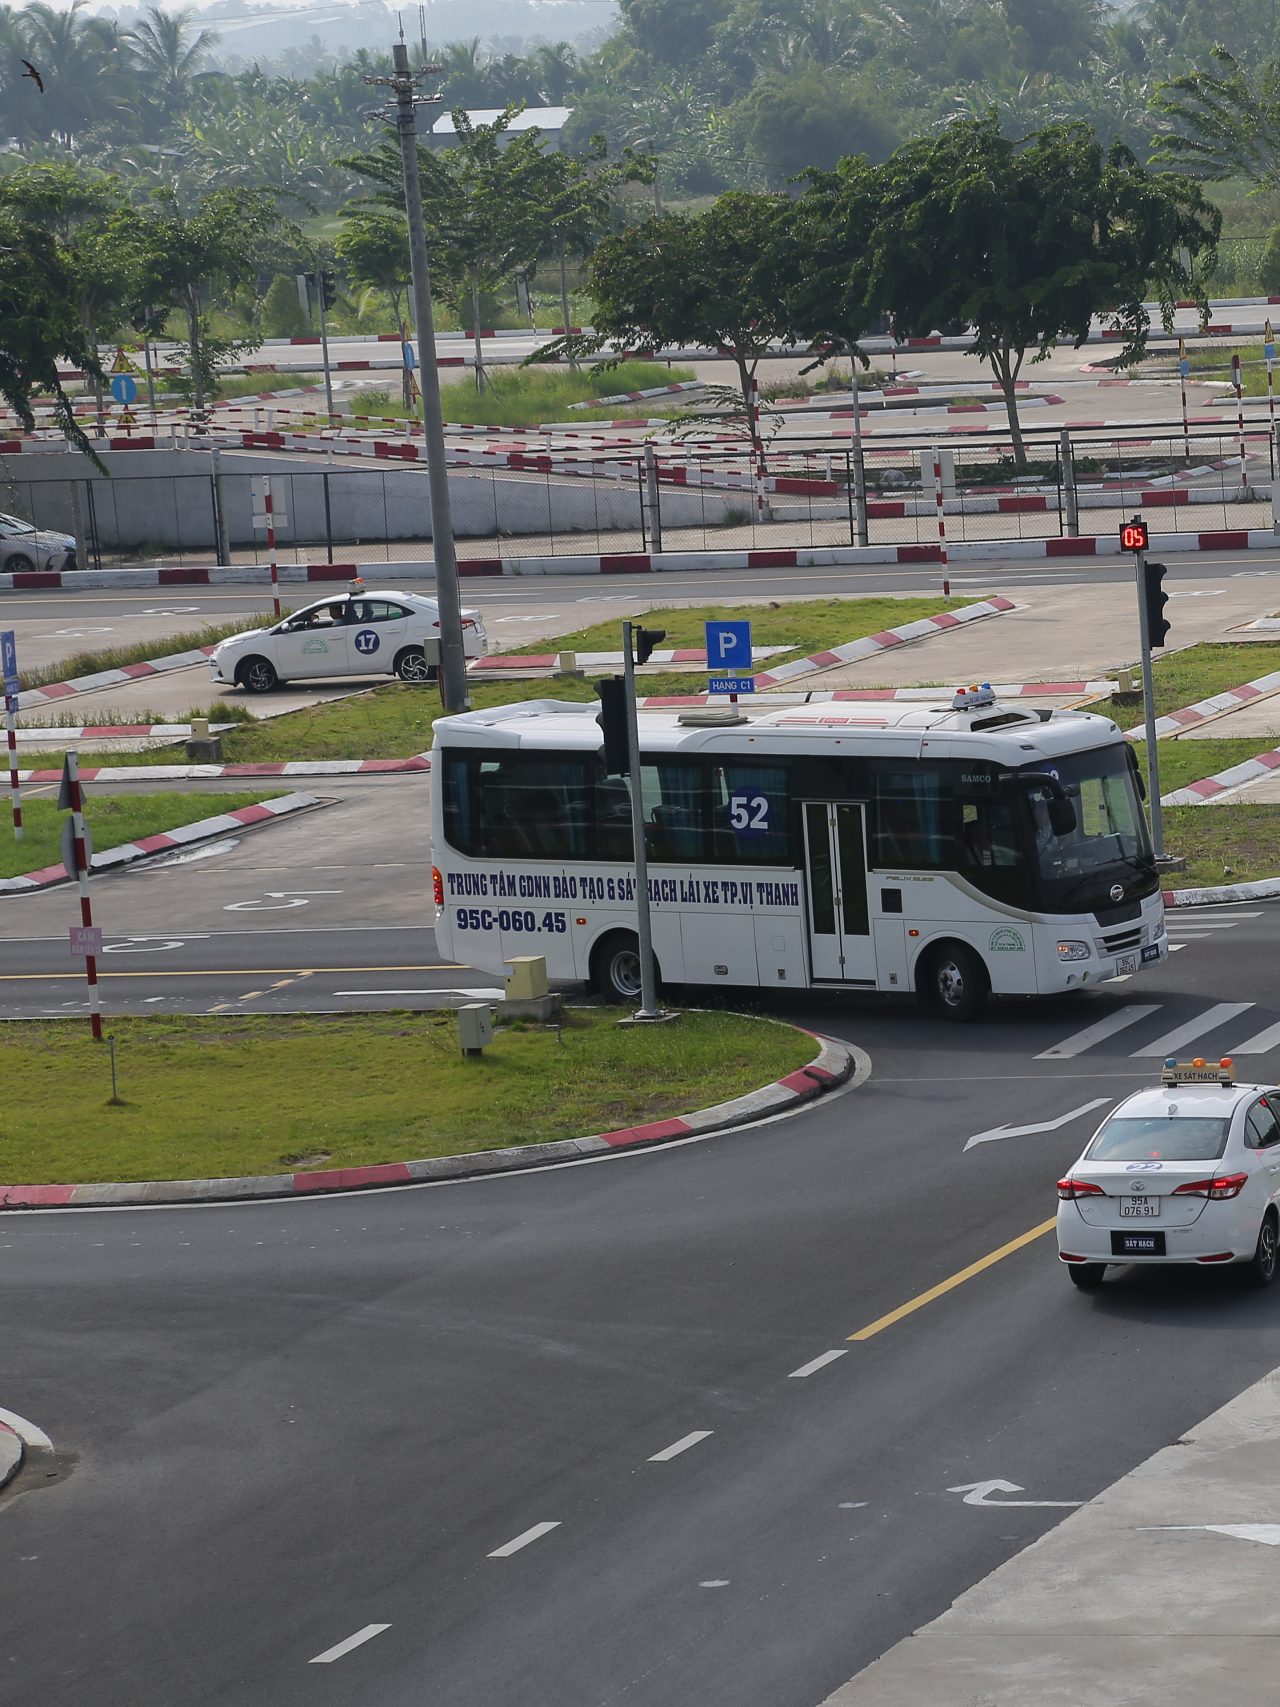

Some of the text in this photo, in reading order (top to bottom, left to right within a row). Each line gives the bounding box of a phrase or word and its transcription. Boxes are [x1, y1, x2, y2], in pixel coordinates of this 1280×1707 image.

[1124, 528, 1144, 547] 05
[359, 634, 376, 650] 17
[719, 632, 737, 658] P
[712, 680, 751, 691] HẠNG C1
[961, 774, 991, 783] SAMCO
[731, 796, 768, 829] 52
[447, 873, 488, 896] TRUNG
[490, 870, 517, 897] TÂM
[519, 874, 551, 899] GDNN
[553, 869, 577, 899] ĐÀO
[580, 876, 604, 904] TẠO
[607, 878, 615, 900] &
[680, 873, 700, 903] LÁI
[703, 881, 719, 904] XE
[756, 882, 799, 906] THANH
[456, 908, 567, 933] 95C-060.45
[1174, 1072, 1183, 1080] XE
[1131, 1196, 1149, 1206] 95A
[1124, 1206, 1154, 1216] 076.91
